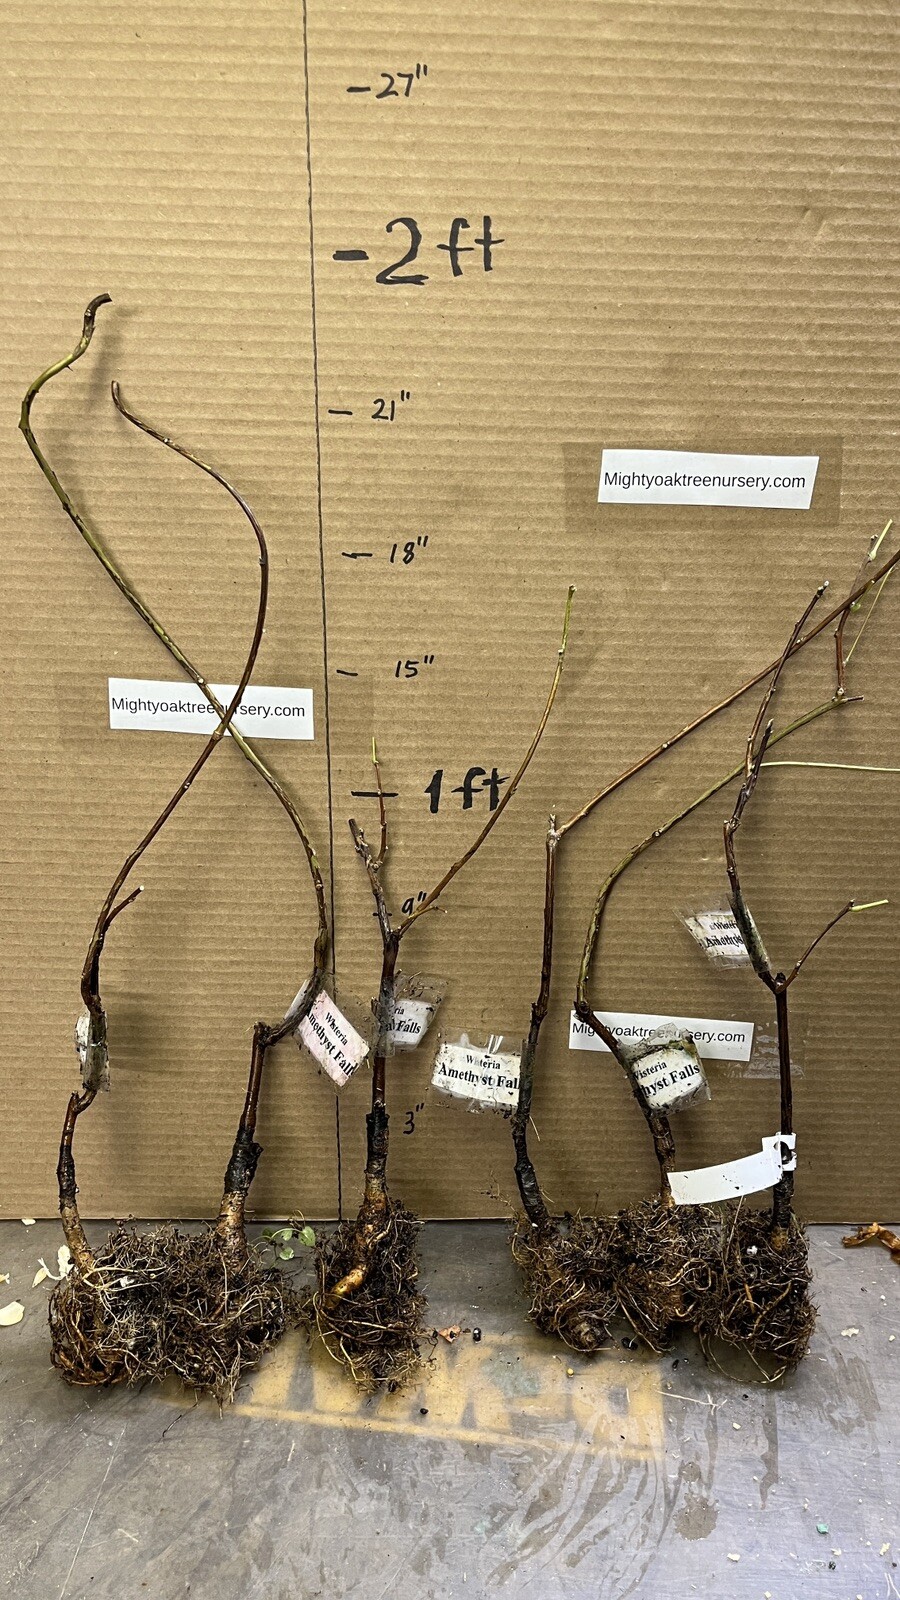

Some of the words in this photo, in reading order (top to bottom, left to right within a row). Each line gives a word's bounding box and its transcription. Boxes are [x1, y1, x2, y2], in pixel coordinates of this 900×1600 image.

[375, 63, 428, 99] 27"
[375, 217, 429, 285] 2
[436, 215, 505, 277] ft
[371, 389, 410, 421] 21"
[603, 471, 806, 491] Mightyoaktreenursery.com
[389, 536, 428, 564] 18"
[395, 655, 434, 678] 15"
[424, 769, 443, 813] 1
[451, 767, 510, 811] ft
[669, 1064, 700, 1085] Falls
[403, 1102, 425, 1135] 3"
